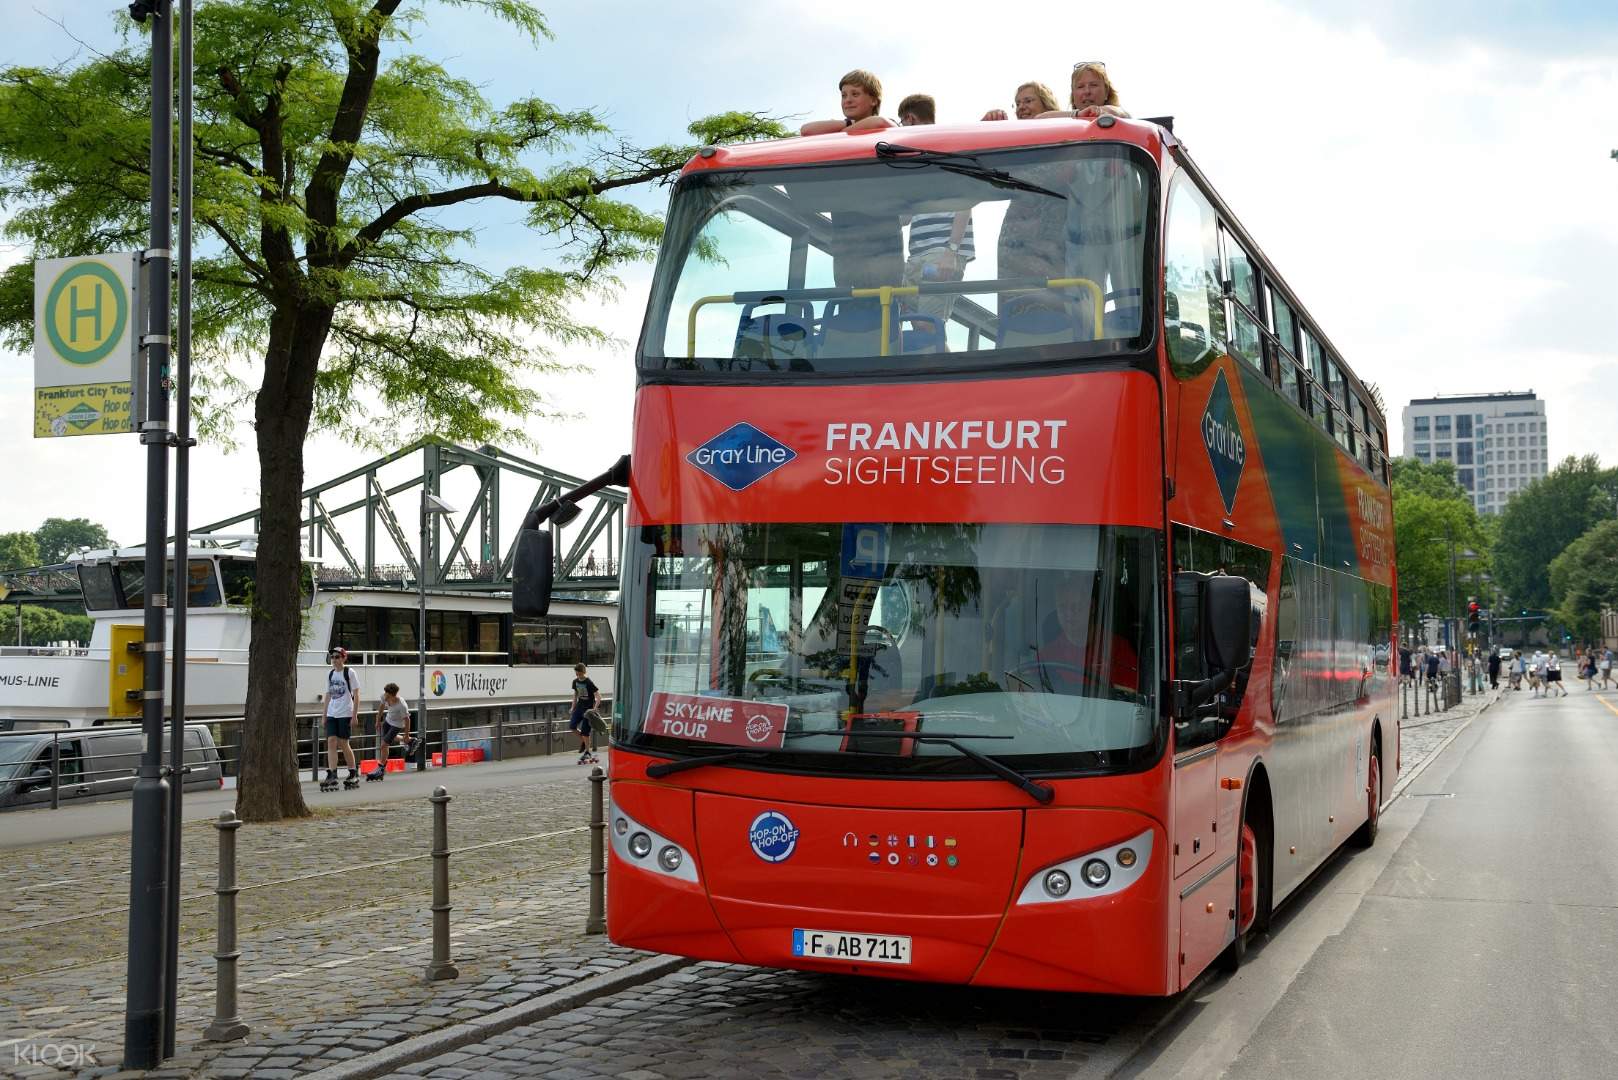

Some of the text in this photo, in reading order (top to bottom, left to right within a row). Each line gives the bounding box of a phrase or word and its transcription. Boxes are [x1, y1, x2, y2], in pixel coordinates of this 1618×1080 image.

[70, 283, 102, 342] H
[39, 385, 129, 400] Frankfurt City Tou
[103, 399, 120, 412] Hop
[102, 417, 119, 430] Hop
[826, 420, 1068, 451] FRANKFURT
[824, 455, 1065, 485] SIGHTSEEING
[0, 675, 60, 688] MUS-LINIE
[454, 672, 507, 696] Wikinger
[664, 702, 734, 723] SKYLINE
[662, 719, 708, 739] TOUR
[750, 824, 786, 841] HOP-ON
[758, 830, 799, 848] HOP-OFF
[811, 934, 824, 954] F
